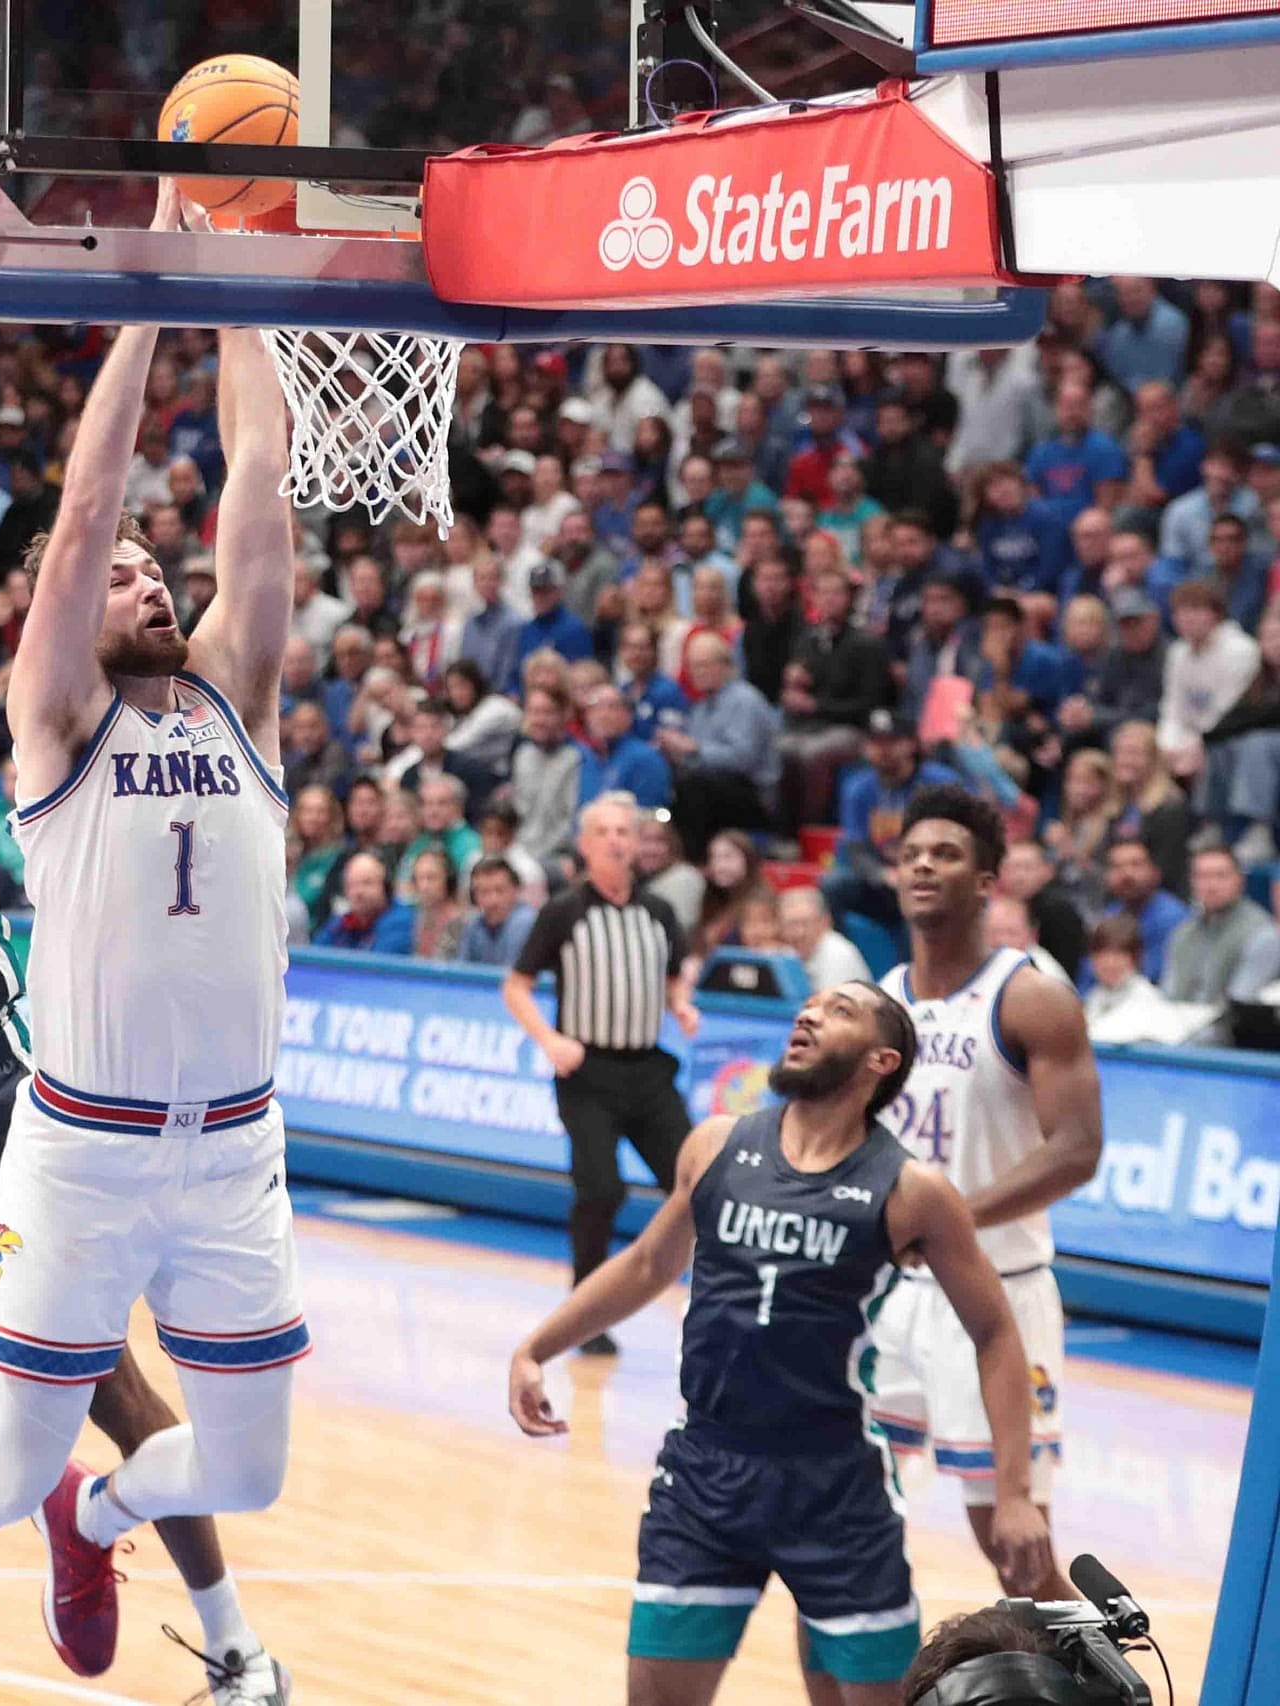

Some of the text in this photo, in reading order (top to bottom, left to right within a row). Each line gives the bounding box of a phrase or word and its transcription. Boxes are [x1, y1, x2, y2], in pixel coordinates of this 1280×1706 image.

[111, 750, 241, 797] KANAS
[168, 821, 200, 916] 1
[325, 1001, 414, 1060] YOUR
[275, 1049, 409, 1112] AYHAWK
[174, 1112, 197, 1128] KU
[1087, 1111, 1279, 1231] ral Ba
[717, 1199, 849, 1266] UNCW
[756, 1264, 778, 1326] 1
